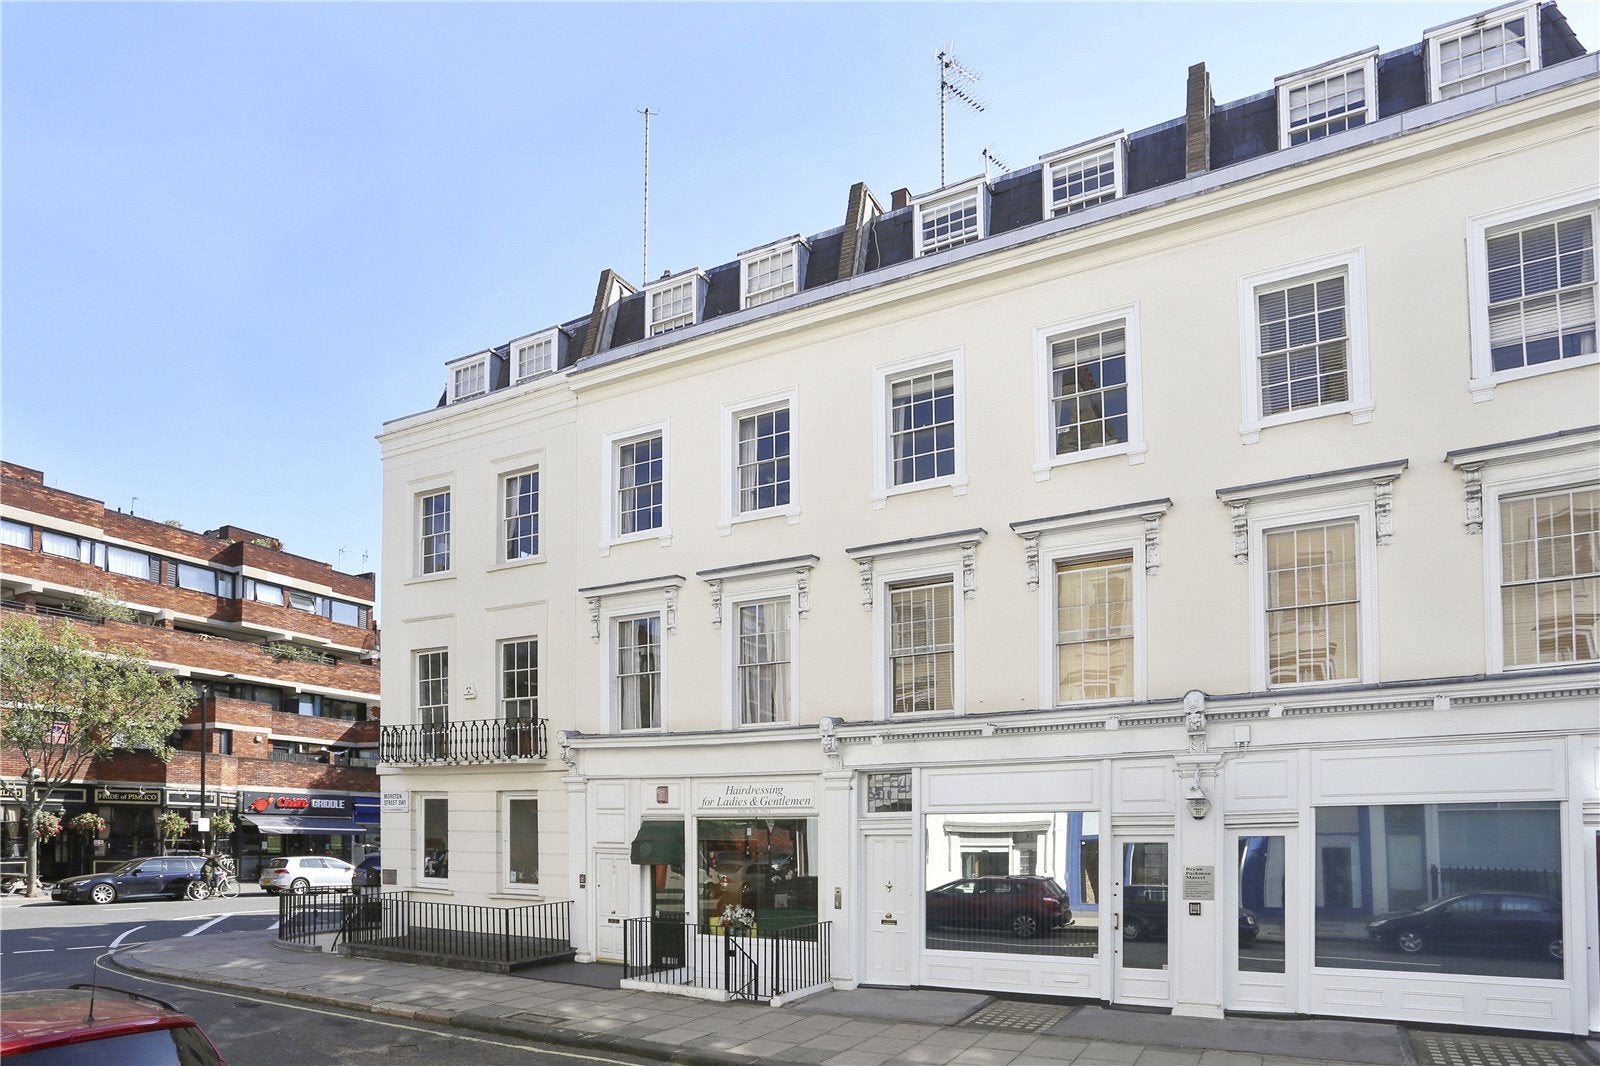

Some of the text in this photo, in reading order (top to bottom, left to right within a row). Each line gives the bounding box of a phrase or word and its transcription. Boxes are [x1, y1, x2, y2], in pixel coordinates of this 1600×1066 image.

[725, 785, 784, 796] Hairdressing
[311, 798, 345, 809] GRIDDLE
[701, 796, 811, 807] for Ladies & Gentlemen
